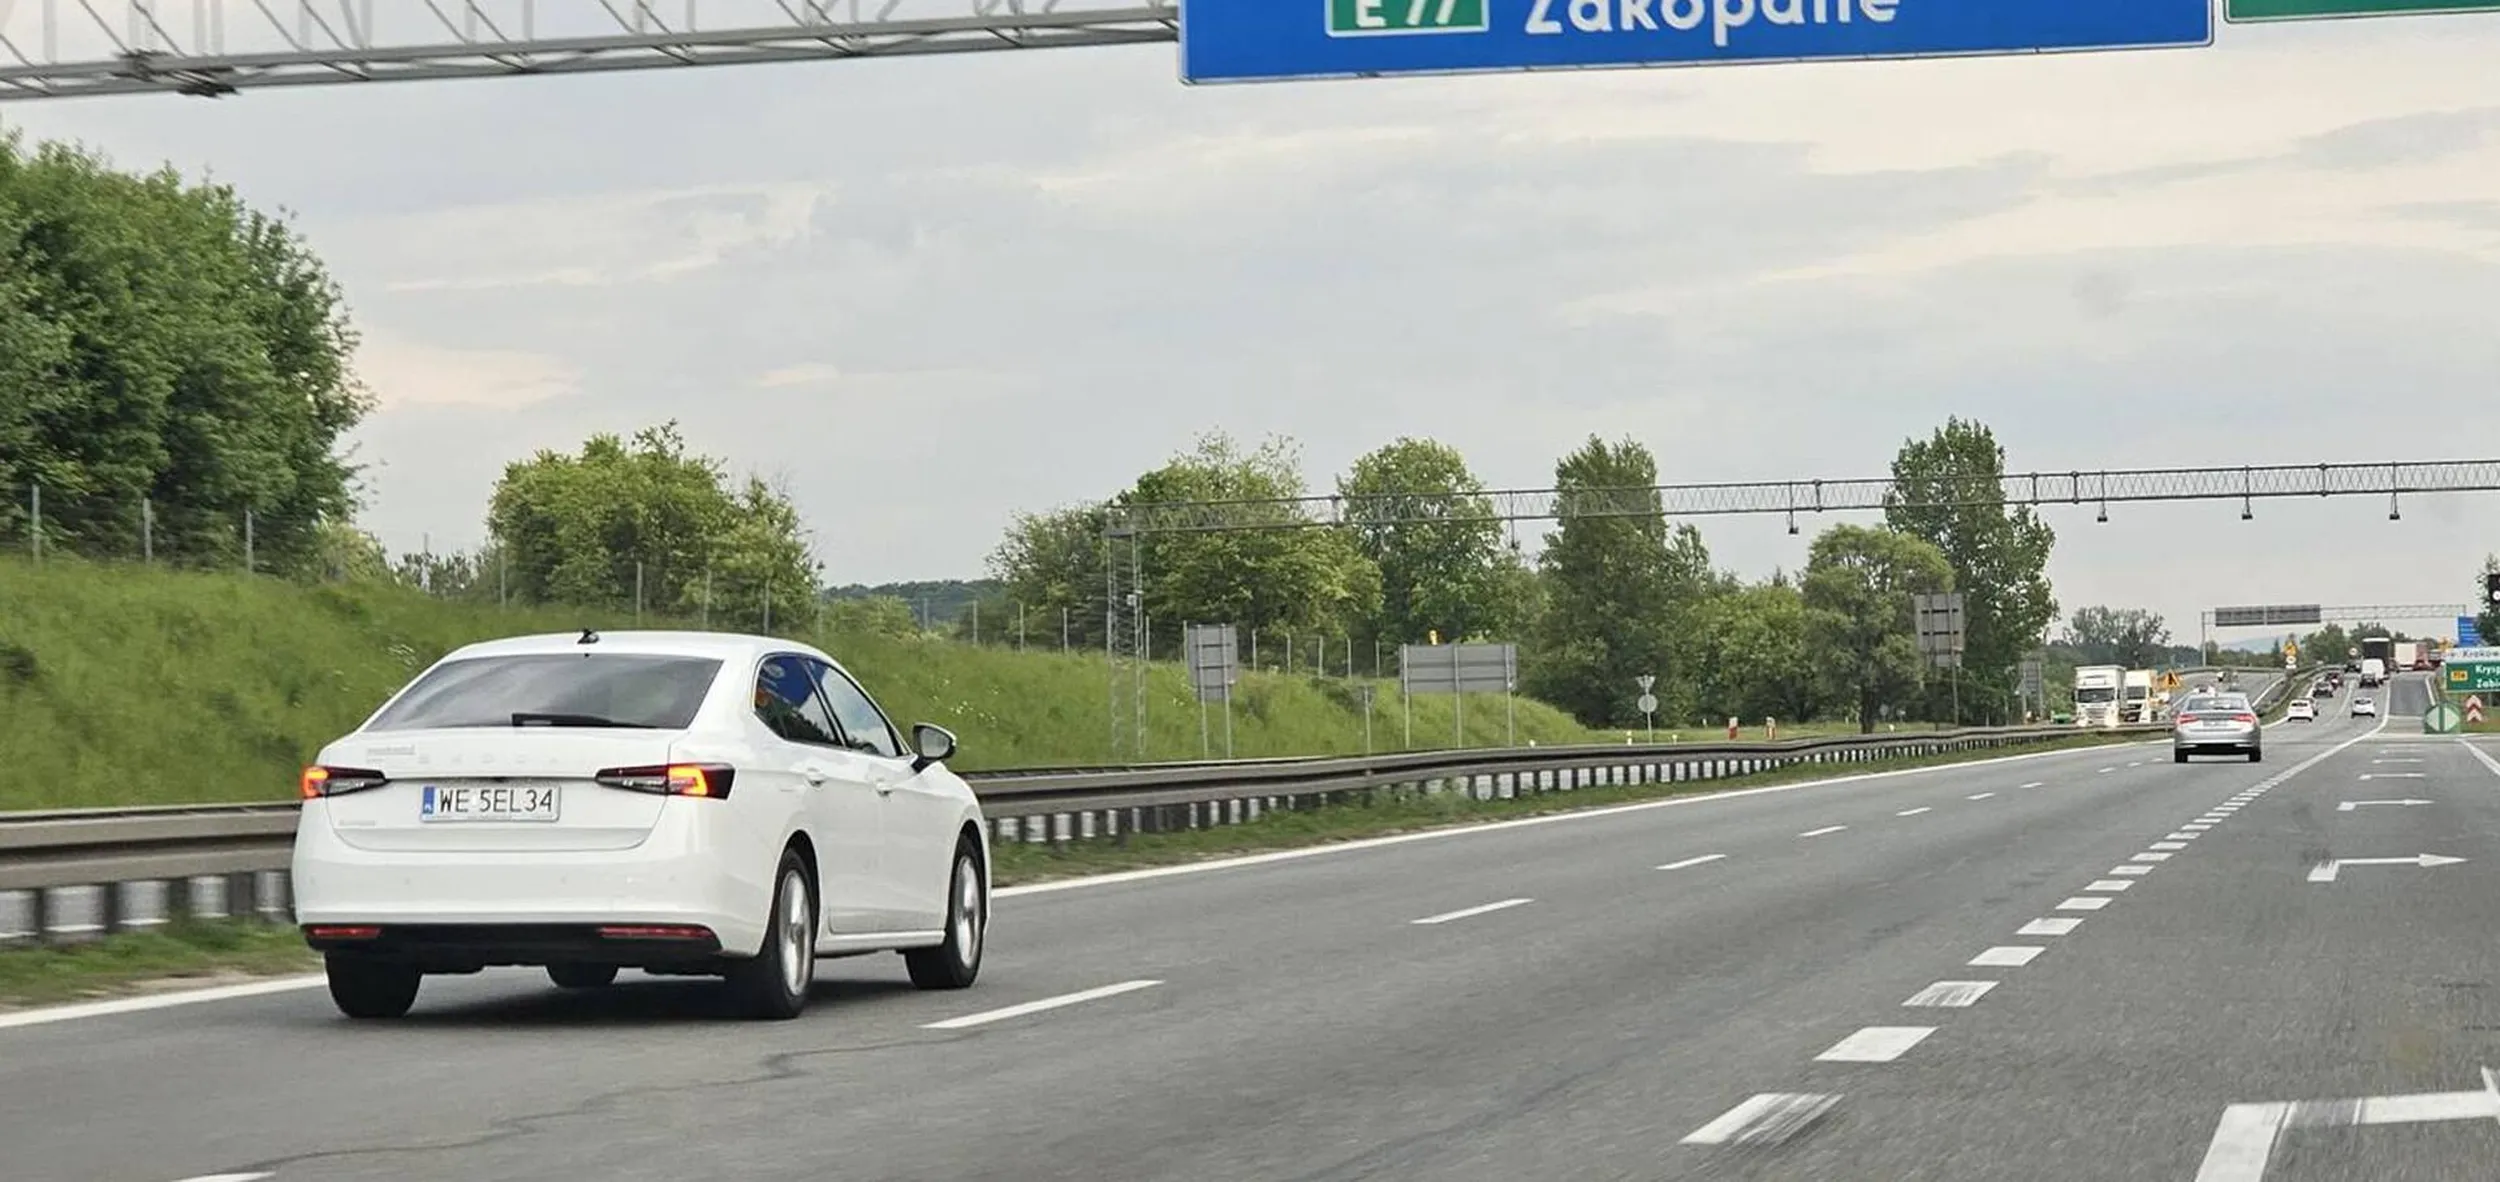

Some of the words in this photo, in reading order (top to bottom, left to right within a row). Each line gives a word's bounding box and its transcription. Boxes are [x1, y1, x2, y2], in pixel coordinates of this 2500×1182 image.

[1525, 0, 1899, 46] Zakopane
[440, 789, 470, 813] WE
[479, 789, 554, 812] 5EL34
